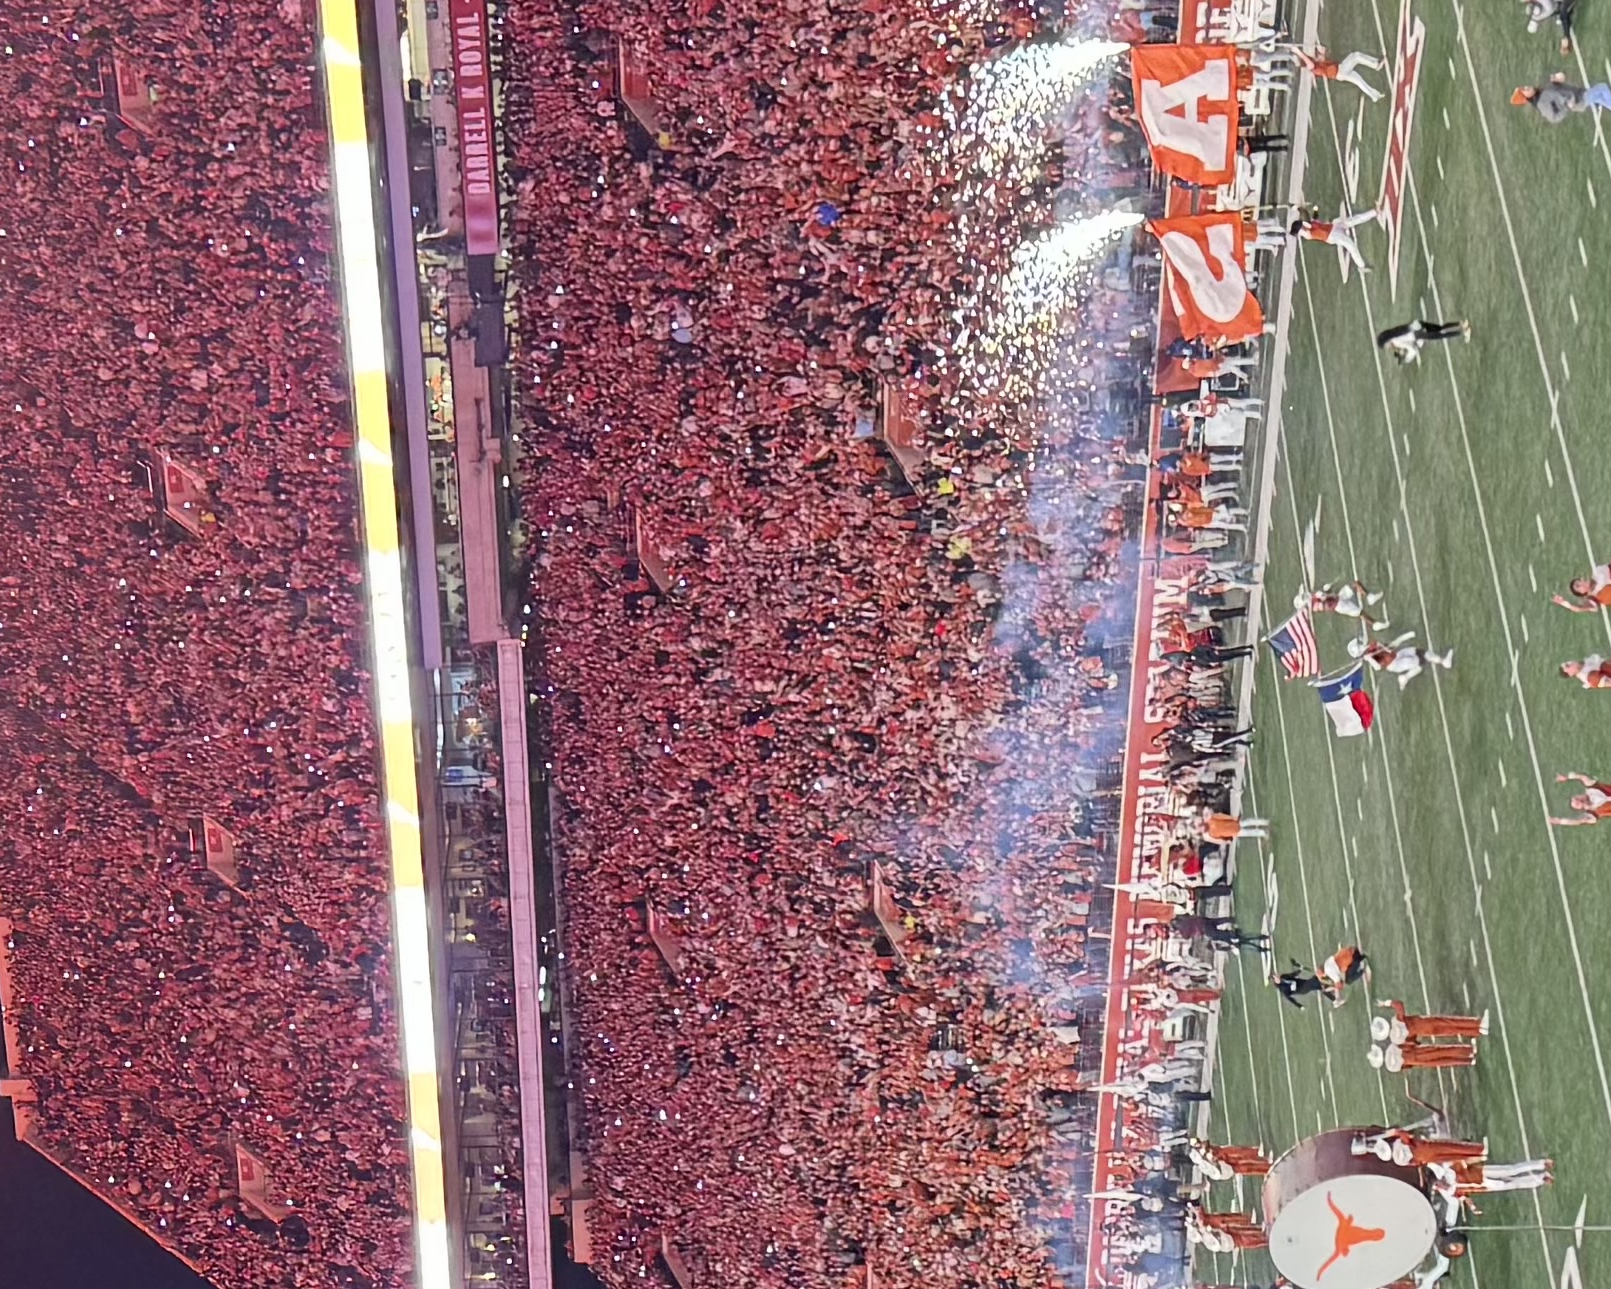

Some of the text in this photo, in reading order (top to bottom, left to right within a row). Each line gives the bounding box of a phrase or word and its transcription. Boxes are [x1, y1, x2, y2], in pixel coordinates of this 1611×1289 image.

[456, 12, 491, 194] DARRELL K ROYAL
[1141, 58, 1230, 171] A
